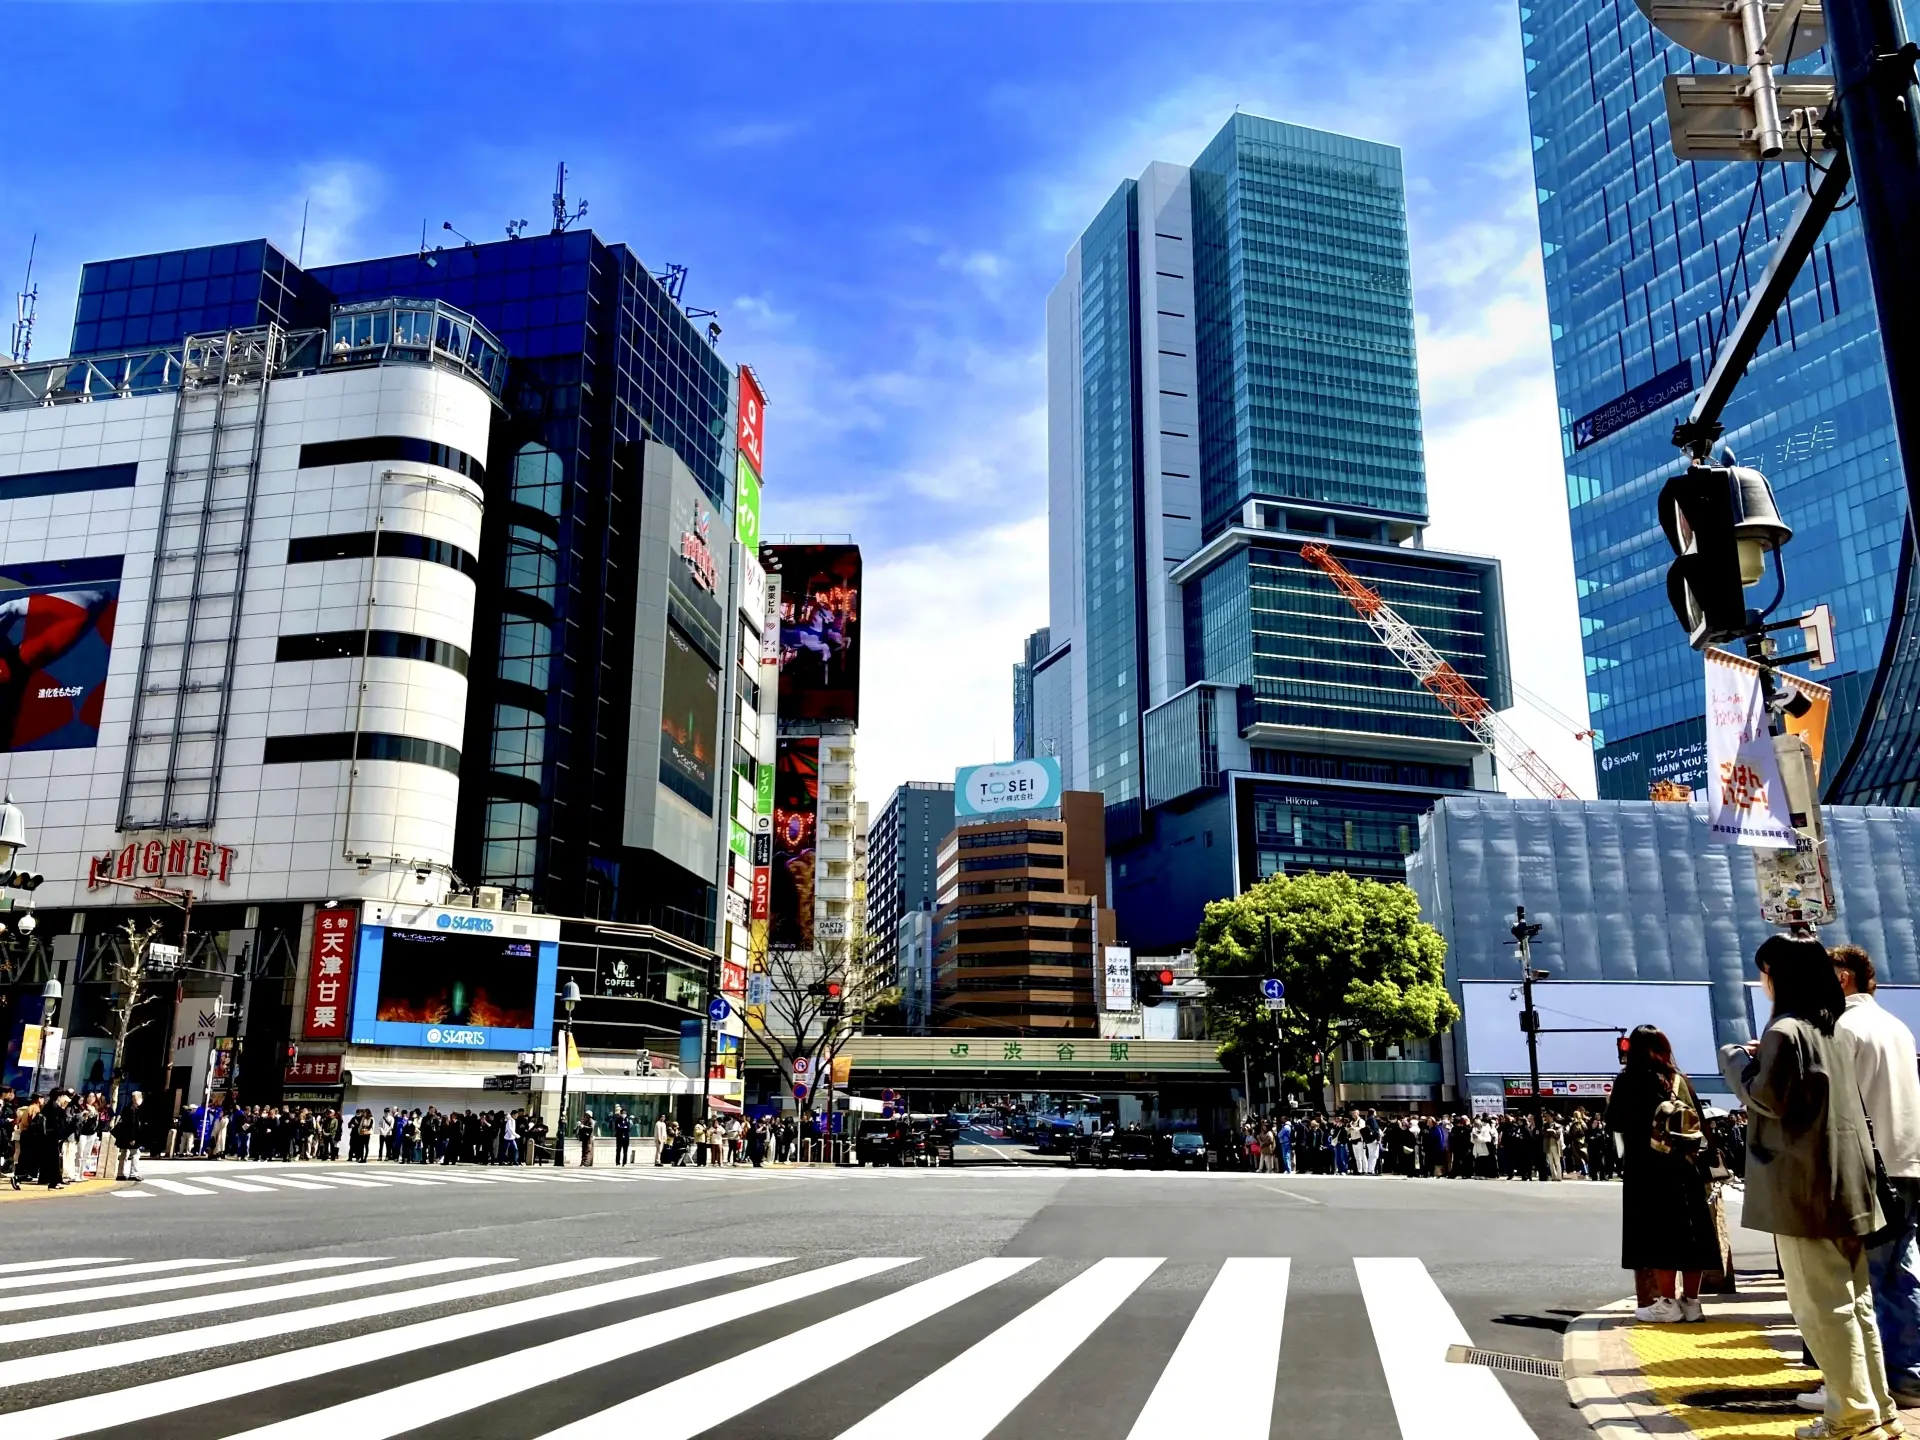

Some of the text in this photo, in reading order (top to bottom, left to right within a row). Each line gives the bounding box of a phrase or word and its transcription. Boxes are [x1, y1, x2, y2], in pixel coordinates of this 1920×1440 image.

[1594, 396, 1637, 425] SHIBUYA
[1595, 377, 1690, 436] SCRAMBLE SQUARE
[739, 467, 755, 537] レイク
[1614, 751, 1640, 766] Spotify
[1682, 756, 1701, 768] YOU
[760, 769, 769, 794] レイク
[1720, 761, 1764, 789] ごはん
[980, 778, 1034, 796] TOSEI
[980, 793, 1034, 804] トーセイ株式会社
[756, 886, 765, 913] アコム
[322, 917, 349, 929] 名物
[1107, 964, 1129, 976] 楽待
[313, 932, 345, 1028] 天津甘栗
[605, 978, 635, 988] COFFEE
[442, 1030, 485, 1046] STARTS
[950, 1044, 969, 1055] JR
[289, 1062, 338, 1075] 天津甘栗
